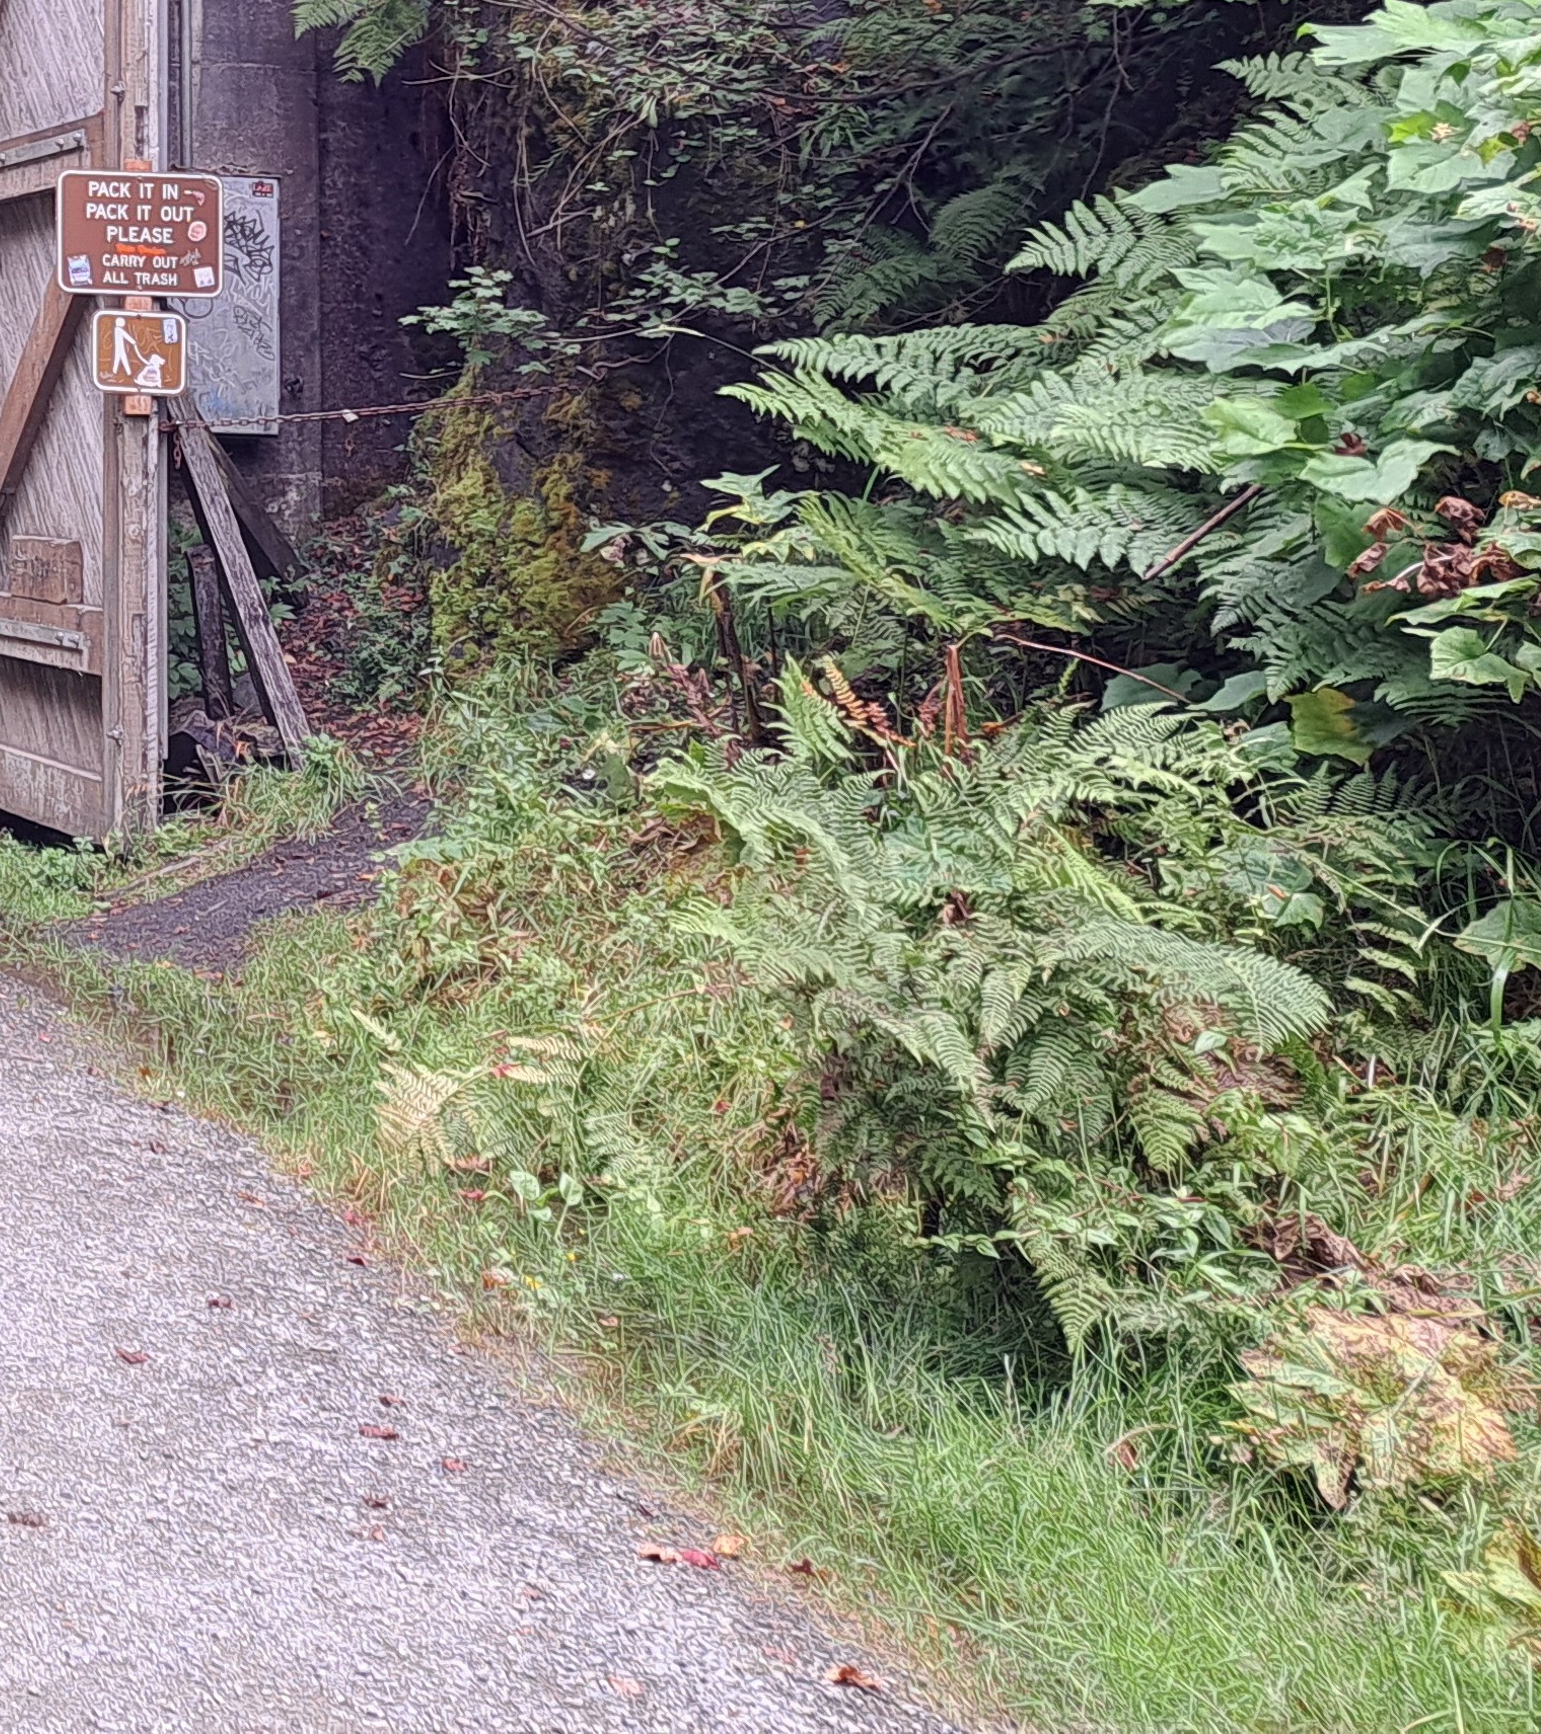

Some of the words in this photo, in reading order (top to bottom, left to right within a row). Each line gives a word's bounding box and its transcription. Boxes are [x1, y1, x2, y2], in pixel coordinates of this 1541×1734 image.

[88, 181, 131, 198] PACK
[139, 182, 155, 199] IT
[162, 183, 179, 200] IN
[86, 203, 128, 220] PACK
[137, 204, 152, 221] IT
[160, 206, 194, 222] OUT
[106, 226, 173, 244] PLEASE
[102, 254, 145, 268] CARRY
[152, 255, 179, 269] OUT
[102, 271, 128, 285] ALL
[134, 272, 178, 286] TRASH
